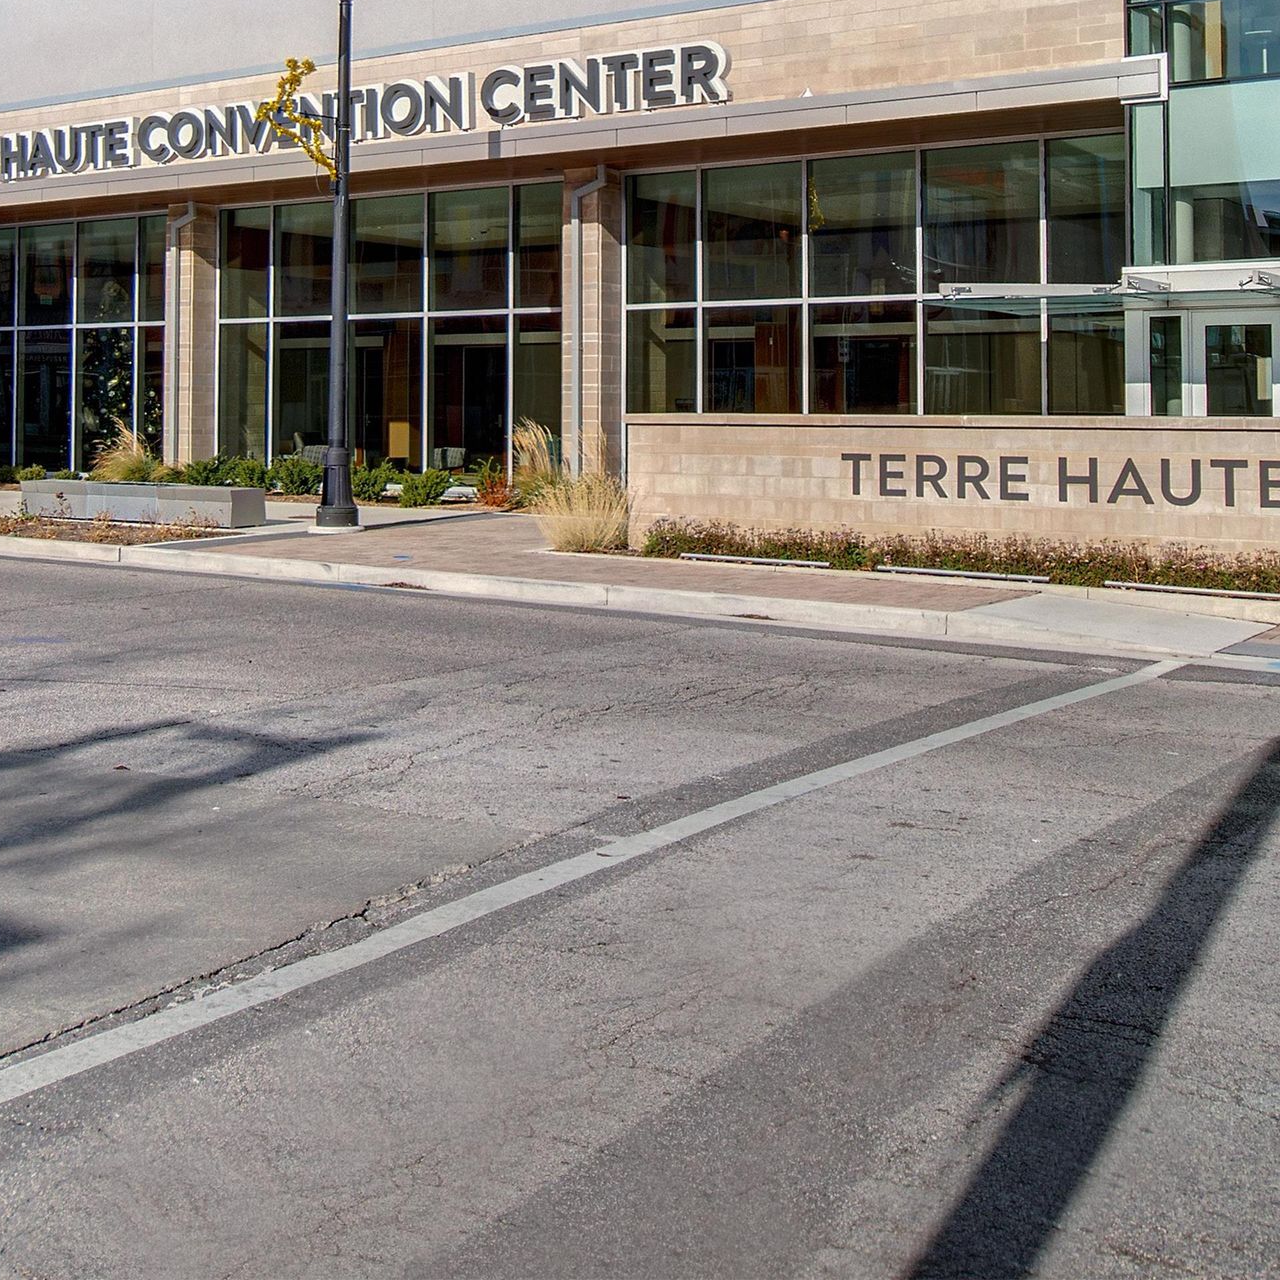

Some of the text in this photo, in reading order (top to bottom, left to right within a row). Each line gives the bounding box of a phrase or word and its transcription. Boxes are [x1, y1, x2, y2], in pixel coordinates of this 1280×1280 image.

[0, 118, 131, 180] HAUTE
[137, 72, 475, 164] CONVENTION
[481, 40, 731, 124] CENTER
[841, 453, 1029, 502] TERRE
